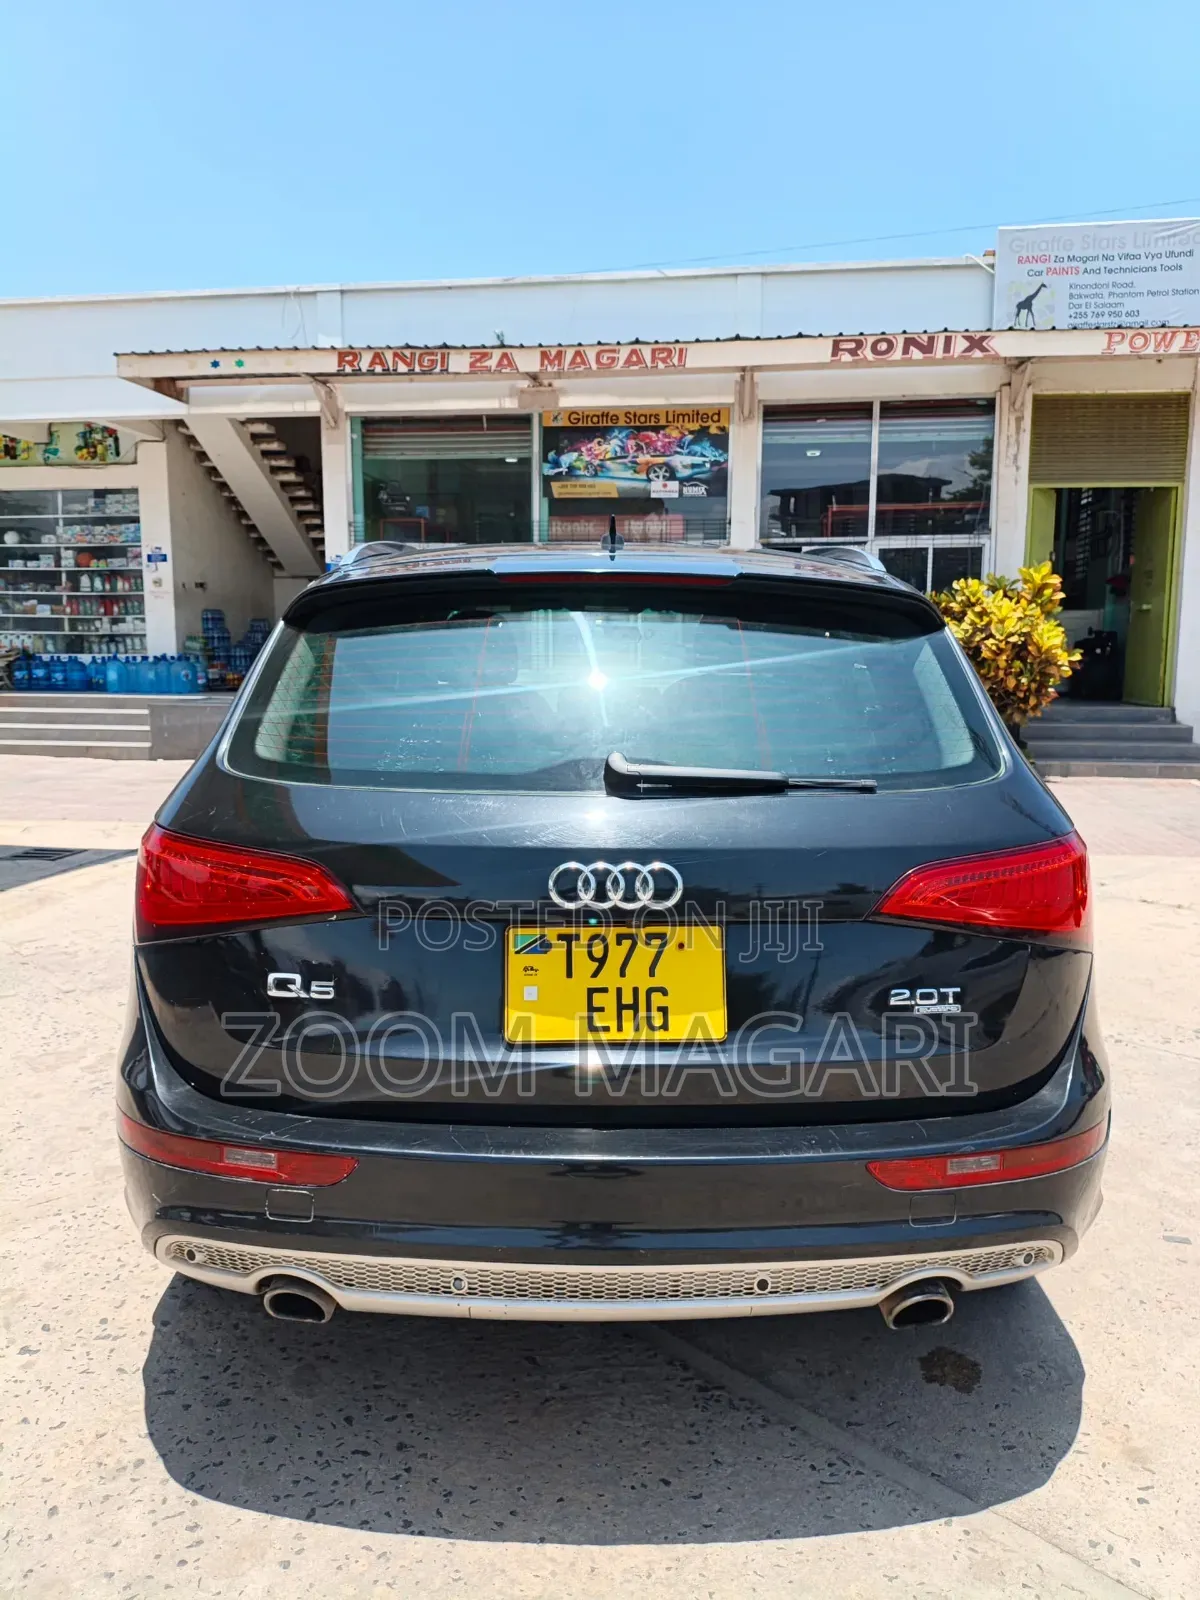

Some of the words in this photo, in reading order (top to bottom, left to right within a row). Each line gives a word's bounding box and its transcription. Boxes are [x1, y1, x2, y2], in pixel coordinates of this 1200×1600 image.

[1010, 234, 1075, 254] Giraffe
[1081, 231, 1126, 251] Stars
[1017, 254, 1051, 265] RANGI
[1053, 255, 1065, 263] Za
[1067, 254, 1099, 264] Magari
[1102, 253, 1115, 261] Na
[1117, 252, 1142, 261] Vifaa
[1144, 251, 1163, 262] Vya
[1164, 249, 1194, 259] Ufundi
[1027, 268, 1043, 277] Car
[1045, 266, 1080, 276] PAINTS
[1082, 266, 1101, 275] And
[1103, 264, 1157, 275] Technicians
[1159, 263, 1183, 272] Tools
[1069, 281, 1110, 290] Kinondoni
[1108, 290, 1145, 299] Phantom
[1146, 289, 1170, 297] Petrol
[1171, 287, 1200, 296] Station
[1068, 302, 1083, 310] Dar
[1085, 302, 1092, 310] El
[1094, 301, 1125, 309] Salaam
[1068, 311, 1088, 320] +255
[1090, 311, 1106, 319] 769
[1108, 310, 1123, 318] 950
[1124, 309, 1140, 318] 603
[830, 334, 1000, 362] RONIX
[336, 347, 452, 373] RANGI
[468, 346, 519, 373] ZA
[539, 346, 688, 372] MAGARI
[567, 411, 620, 425] Giraffe
[624, 410, 661, 425] Stars
[665, 409, 721, 425] Limited
[557, 932, 669, 979] T977
[267, 972, 335, 999] Q5
[889, 987, 961, 1005] 2.0T
[586, 986, 669, 1033] EHG
